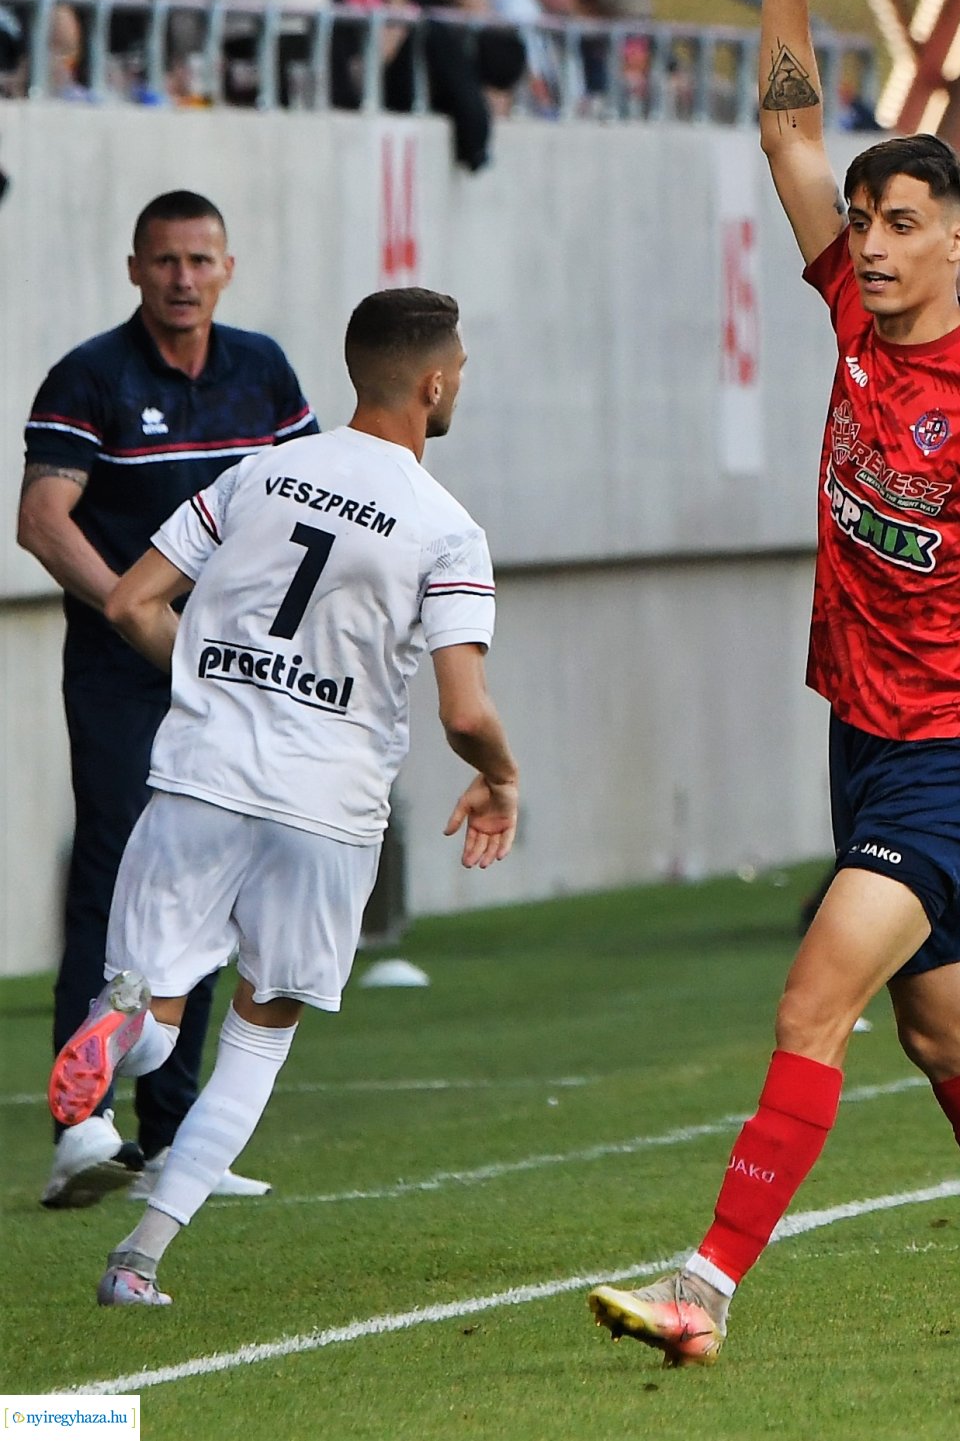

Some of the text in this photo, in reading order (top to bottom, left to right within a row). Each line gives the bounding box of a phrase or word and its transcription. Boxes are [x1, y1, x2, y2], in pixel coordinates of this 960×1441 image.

[845, 355, 868, 388] JAKO
[265, 476, 397, 538] VESZPRÉM
[920, 504, 937, 514] WAY
[198, 646, 354, 709] practical
[860, 842, 902, 864] JAKO
[728, 1155, 775, 1183] JAKO
